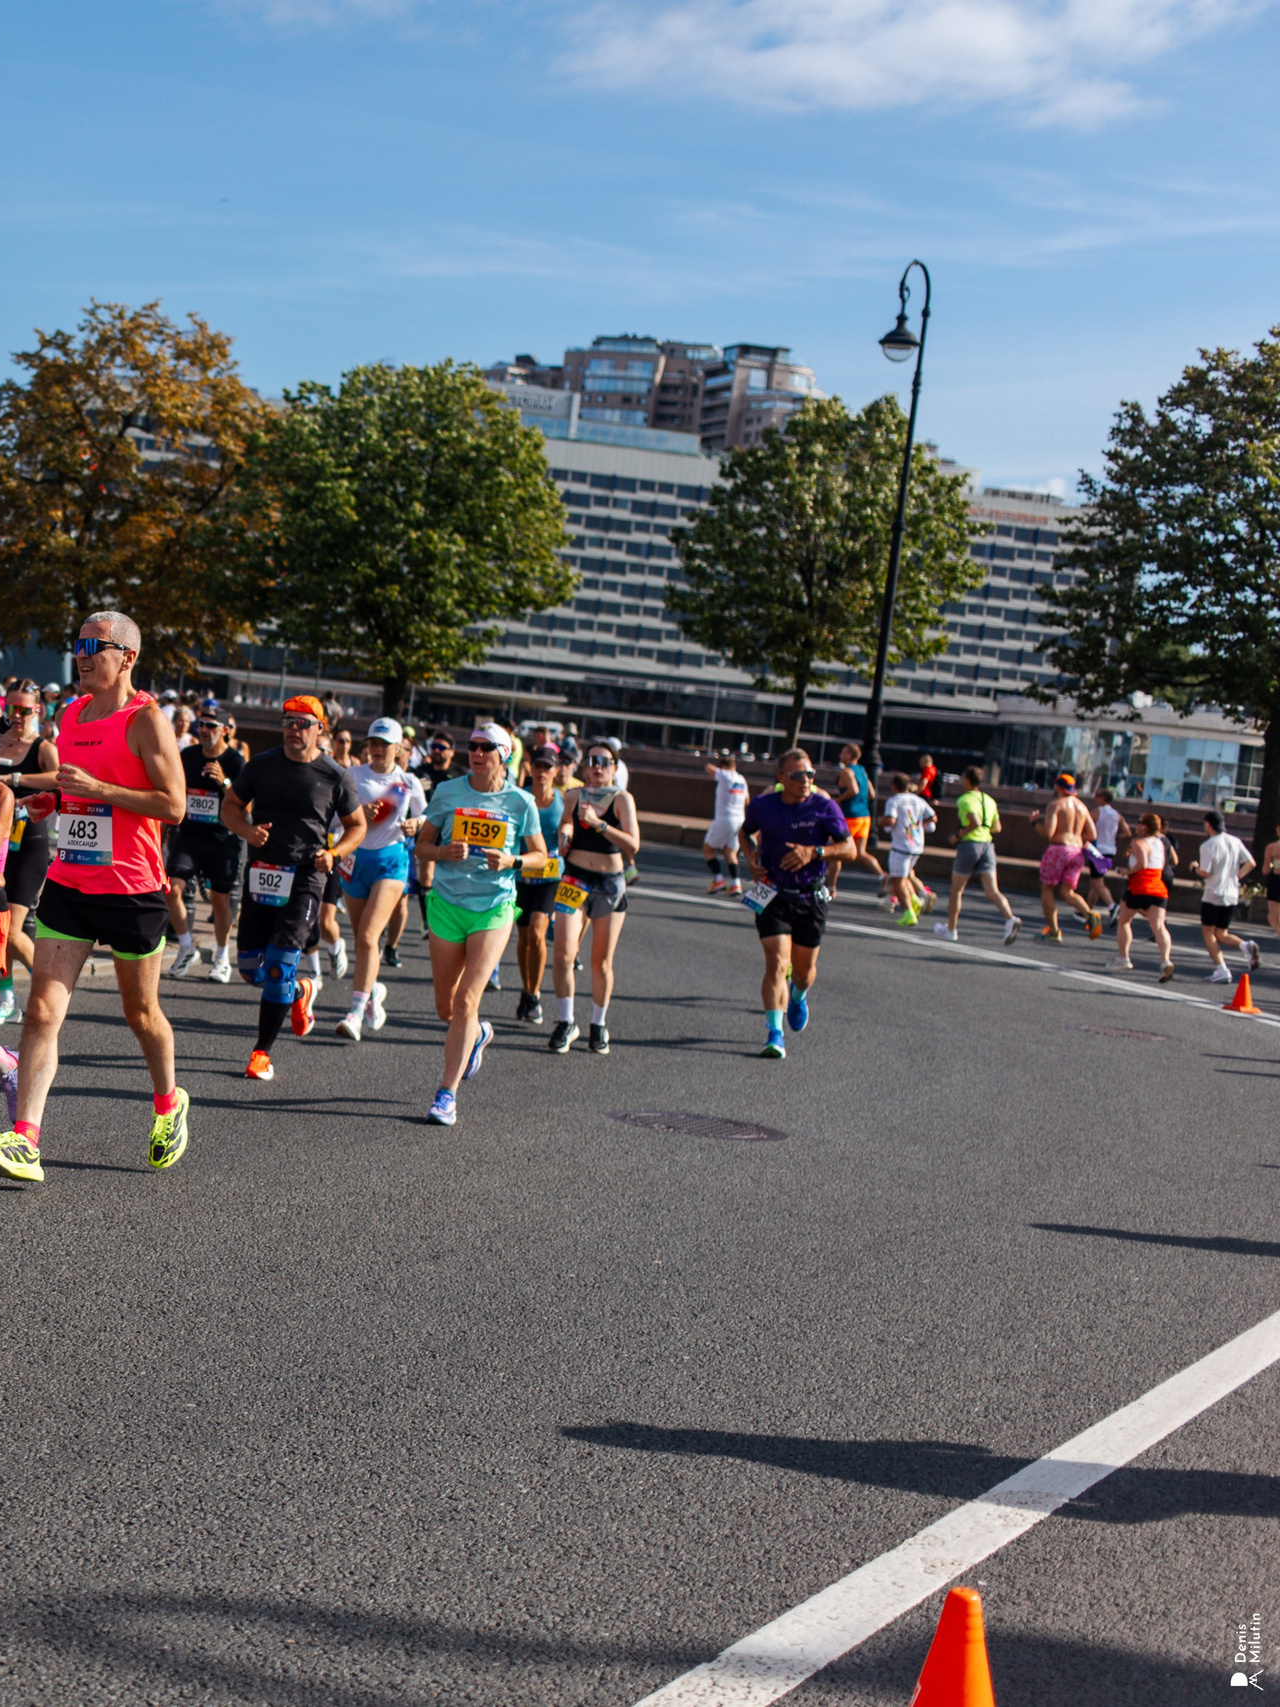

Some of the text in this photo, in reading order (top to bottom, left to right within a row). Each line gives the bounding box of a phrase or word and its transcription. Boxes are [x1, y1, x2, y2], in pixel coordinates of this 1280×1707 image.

[190, 797, 215, 810] 2802
[68, 819, 97, 840] 483
[462, 820, 500, 839] 1539
[67, 839, 98, 848] АЛЕКСАНДР
[258, 872, 283, 889] 502
